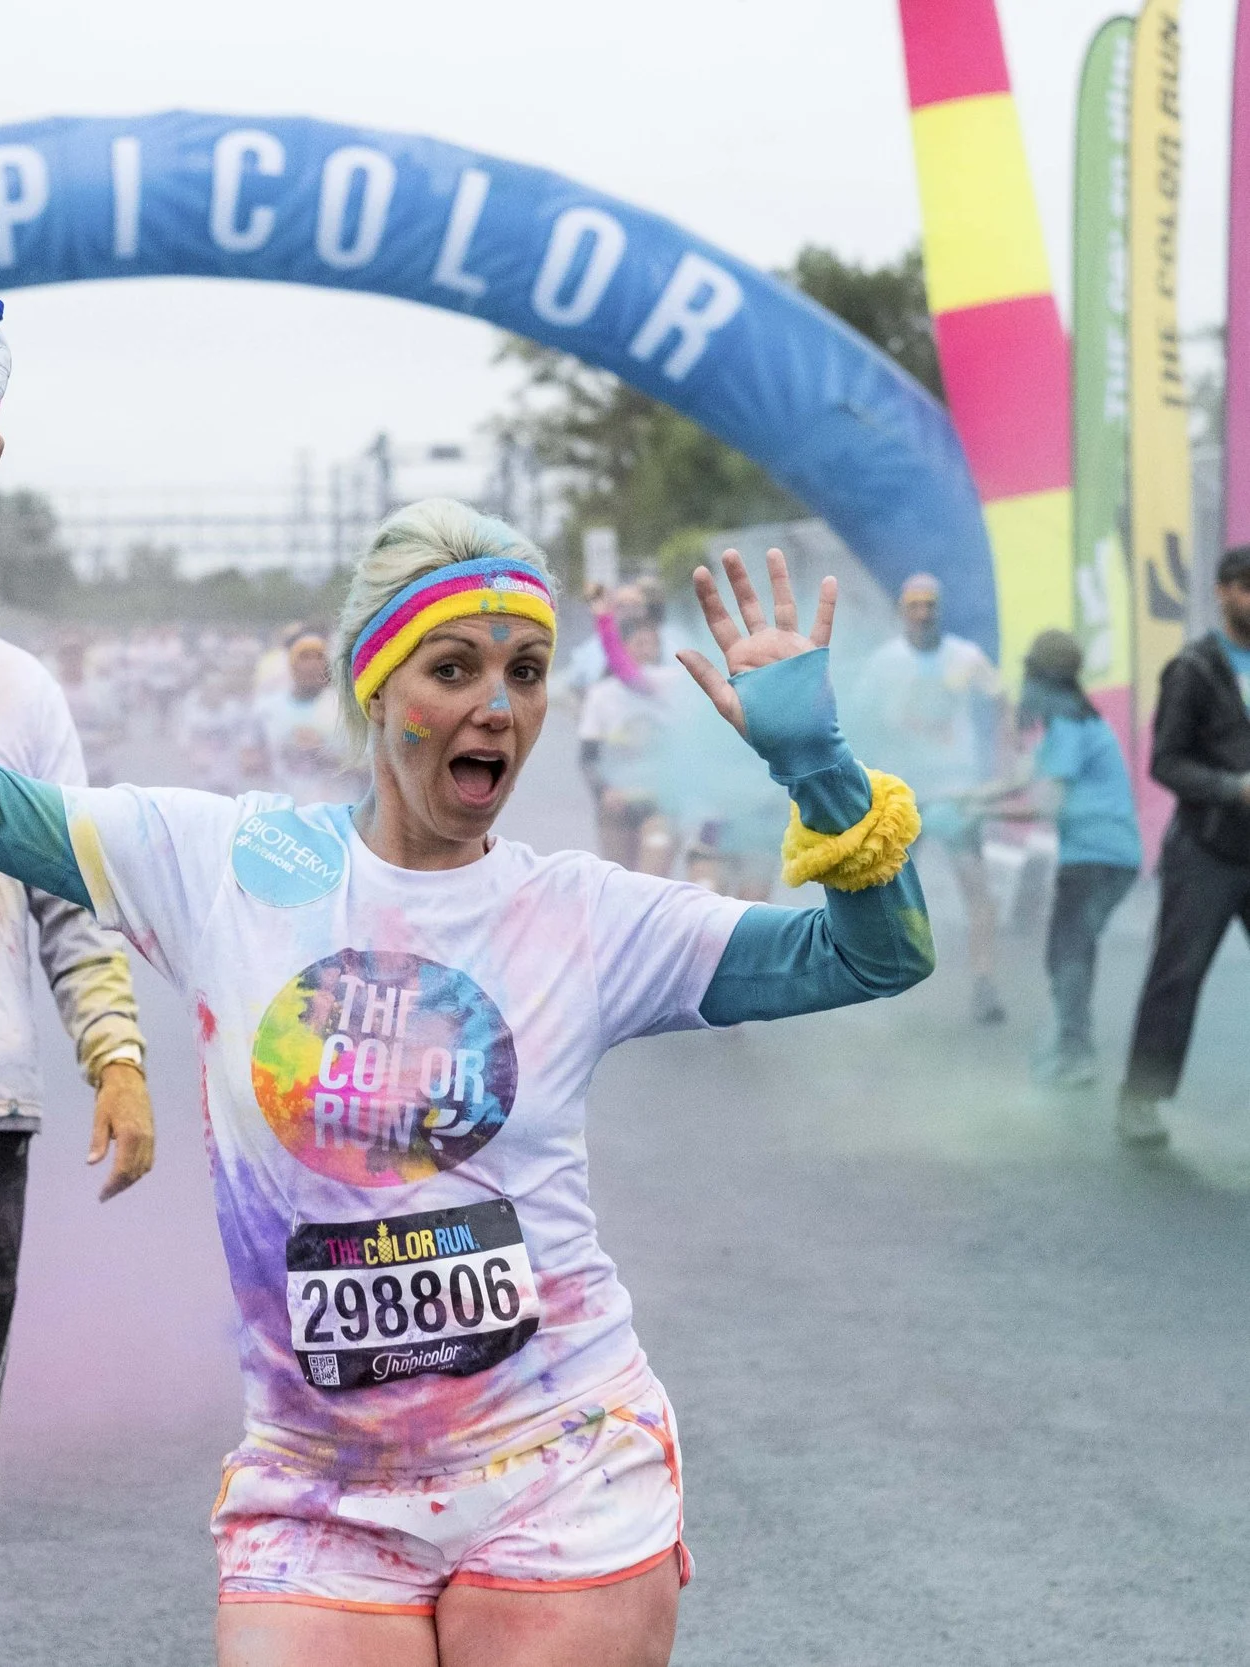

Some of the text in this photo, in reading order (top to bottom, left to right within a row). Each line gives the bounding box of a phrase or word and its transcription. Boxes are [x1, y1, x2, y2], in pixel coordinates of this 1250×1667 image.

[244, 815, 339, 882] BIOTHERM
[318, 1033, 486, 1105] COLOR
[314, 1092, 419, 1153] RUN
[326, 1236, 364, 1266] THE
[435, 1223, 477, 1256] RUN
[301, 1257, 521, 1343] 298806
[371, 1341, 463, 1381] Tropicolor
